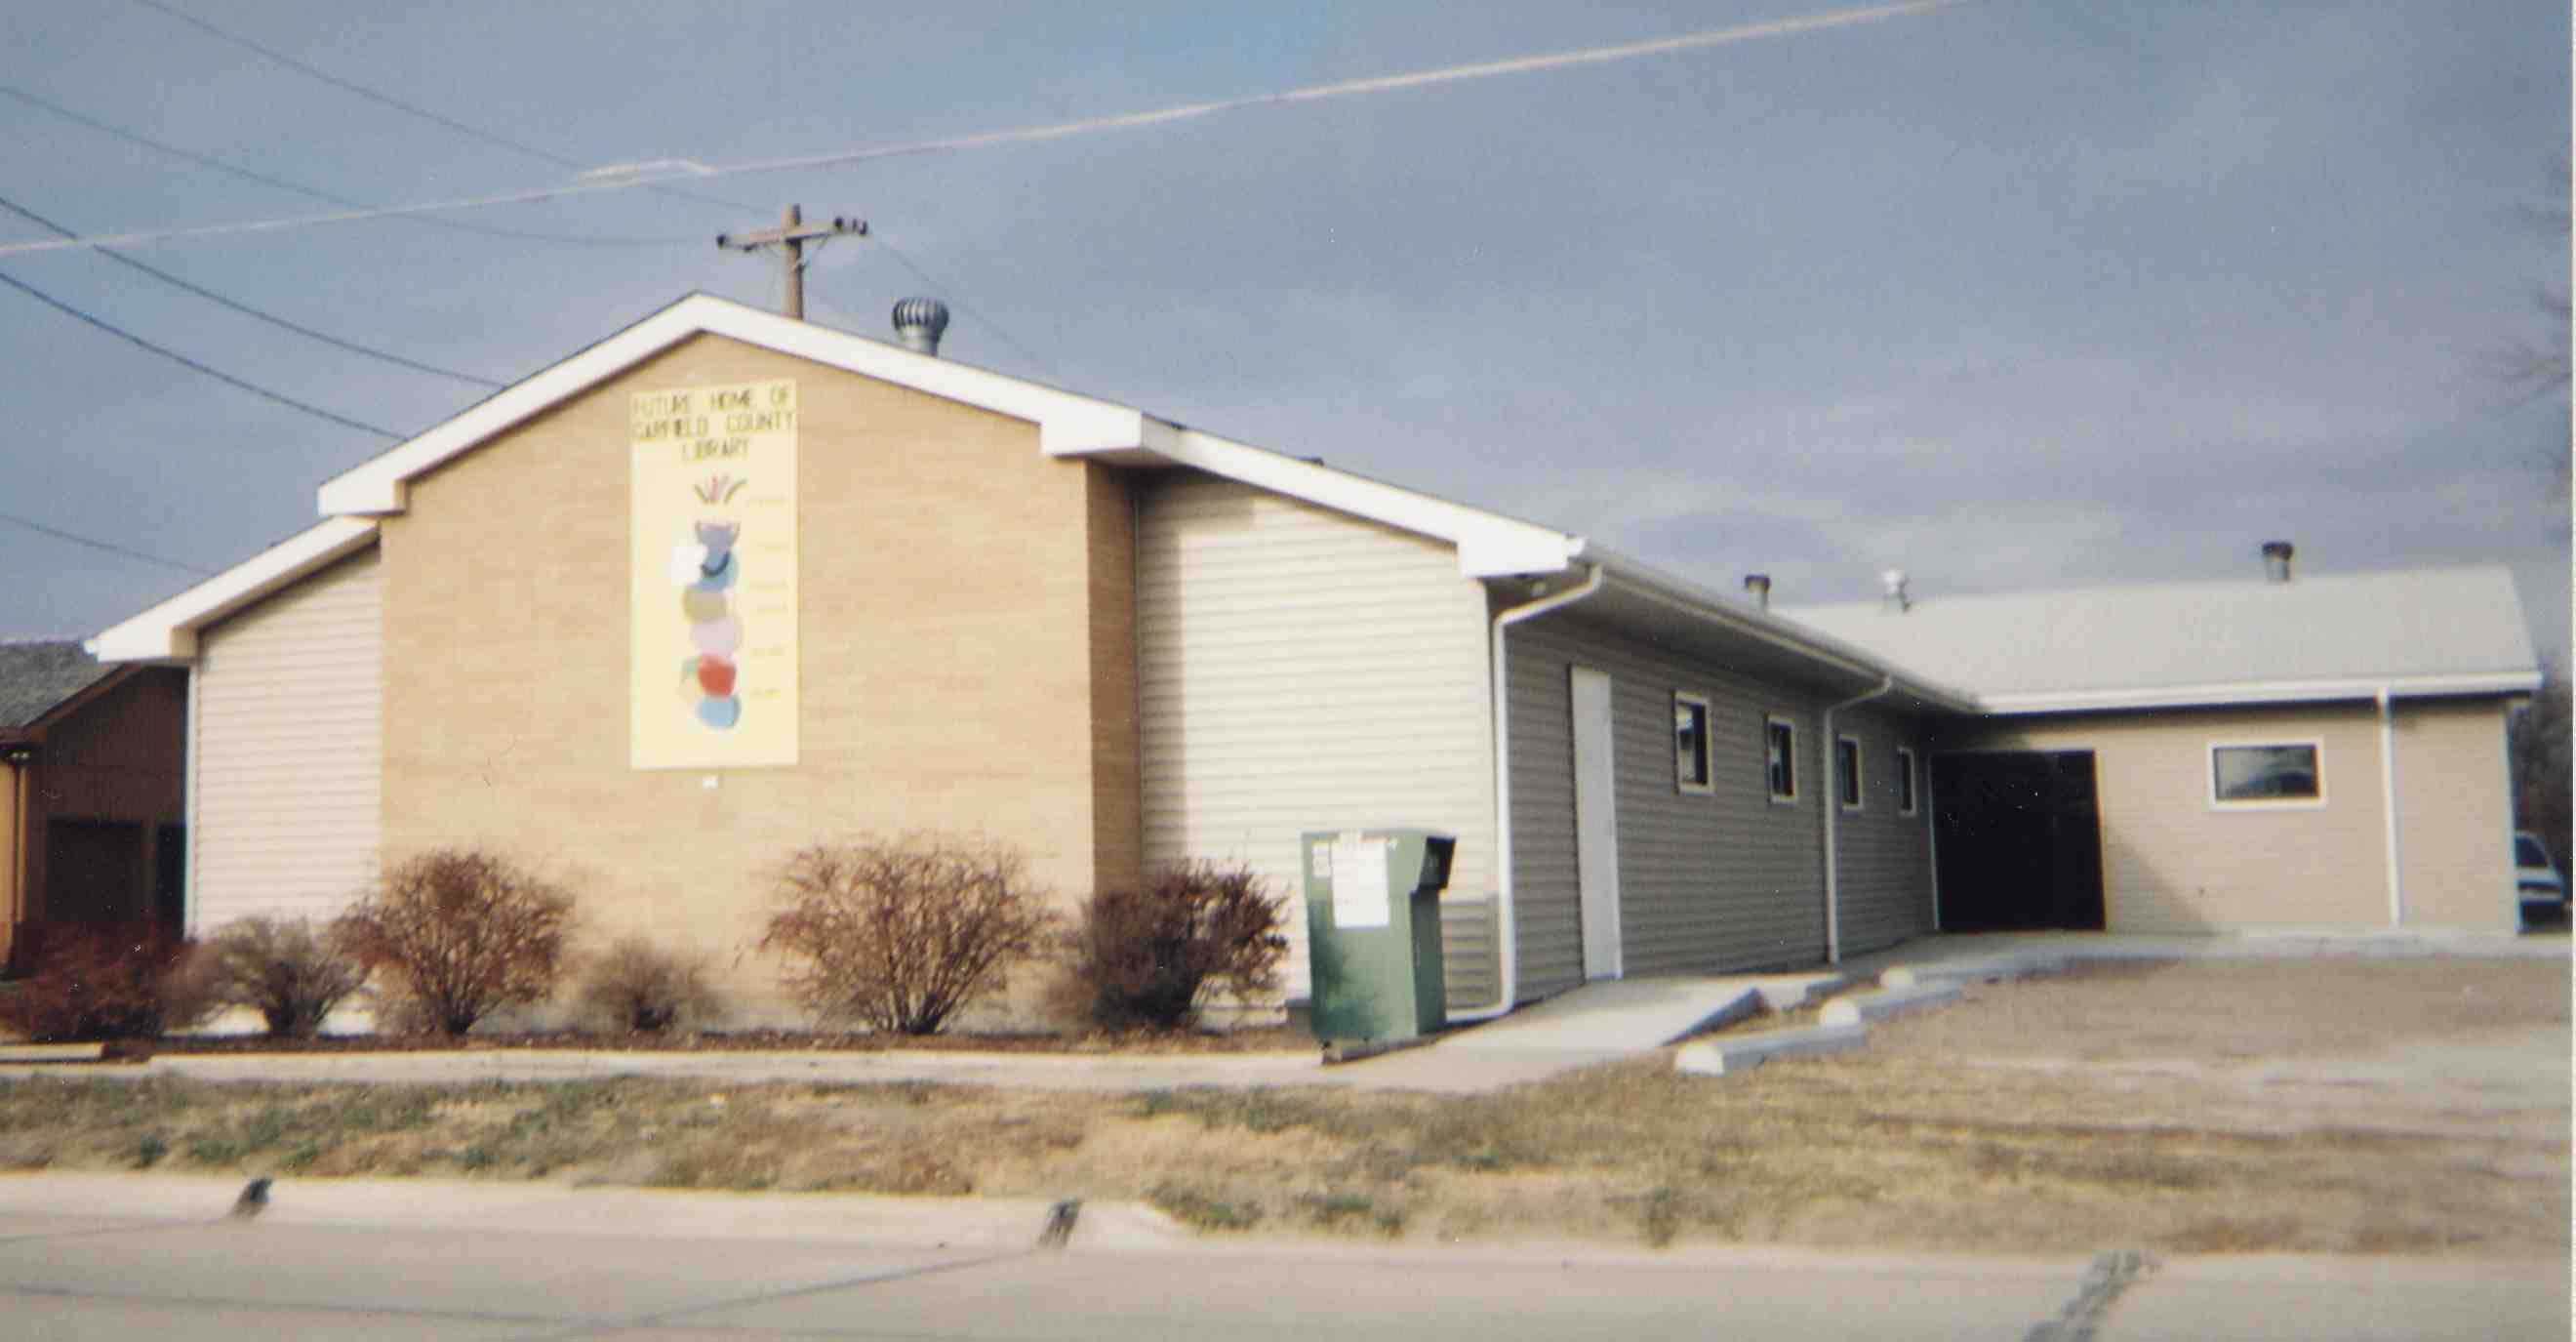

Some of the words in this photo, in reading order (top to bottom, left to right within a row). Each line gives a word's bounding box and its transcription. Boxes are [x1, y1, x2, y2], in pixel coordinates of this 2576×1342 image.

[709, 388, 751, 411] HOME
[769, 385, 789, 406] OF
[726, 410, 794, 433] COUNTY
[682, 437, 749, 463] LIBRARY
